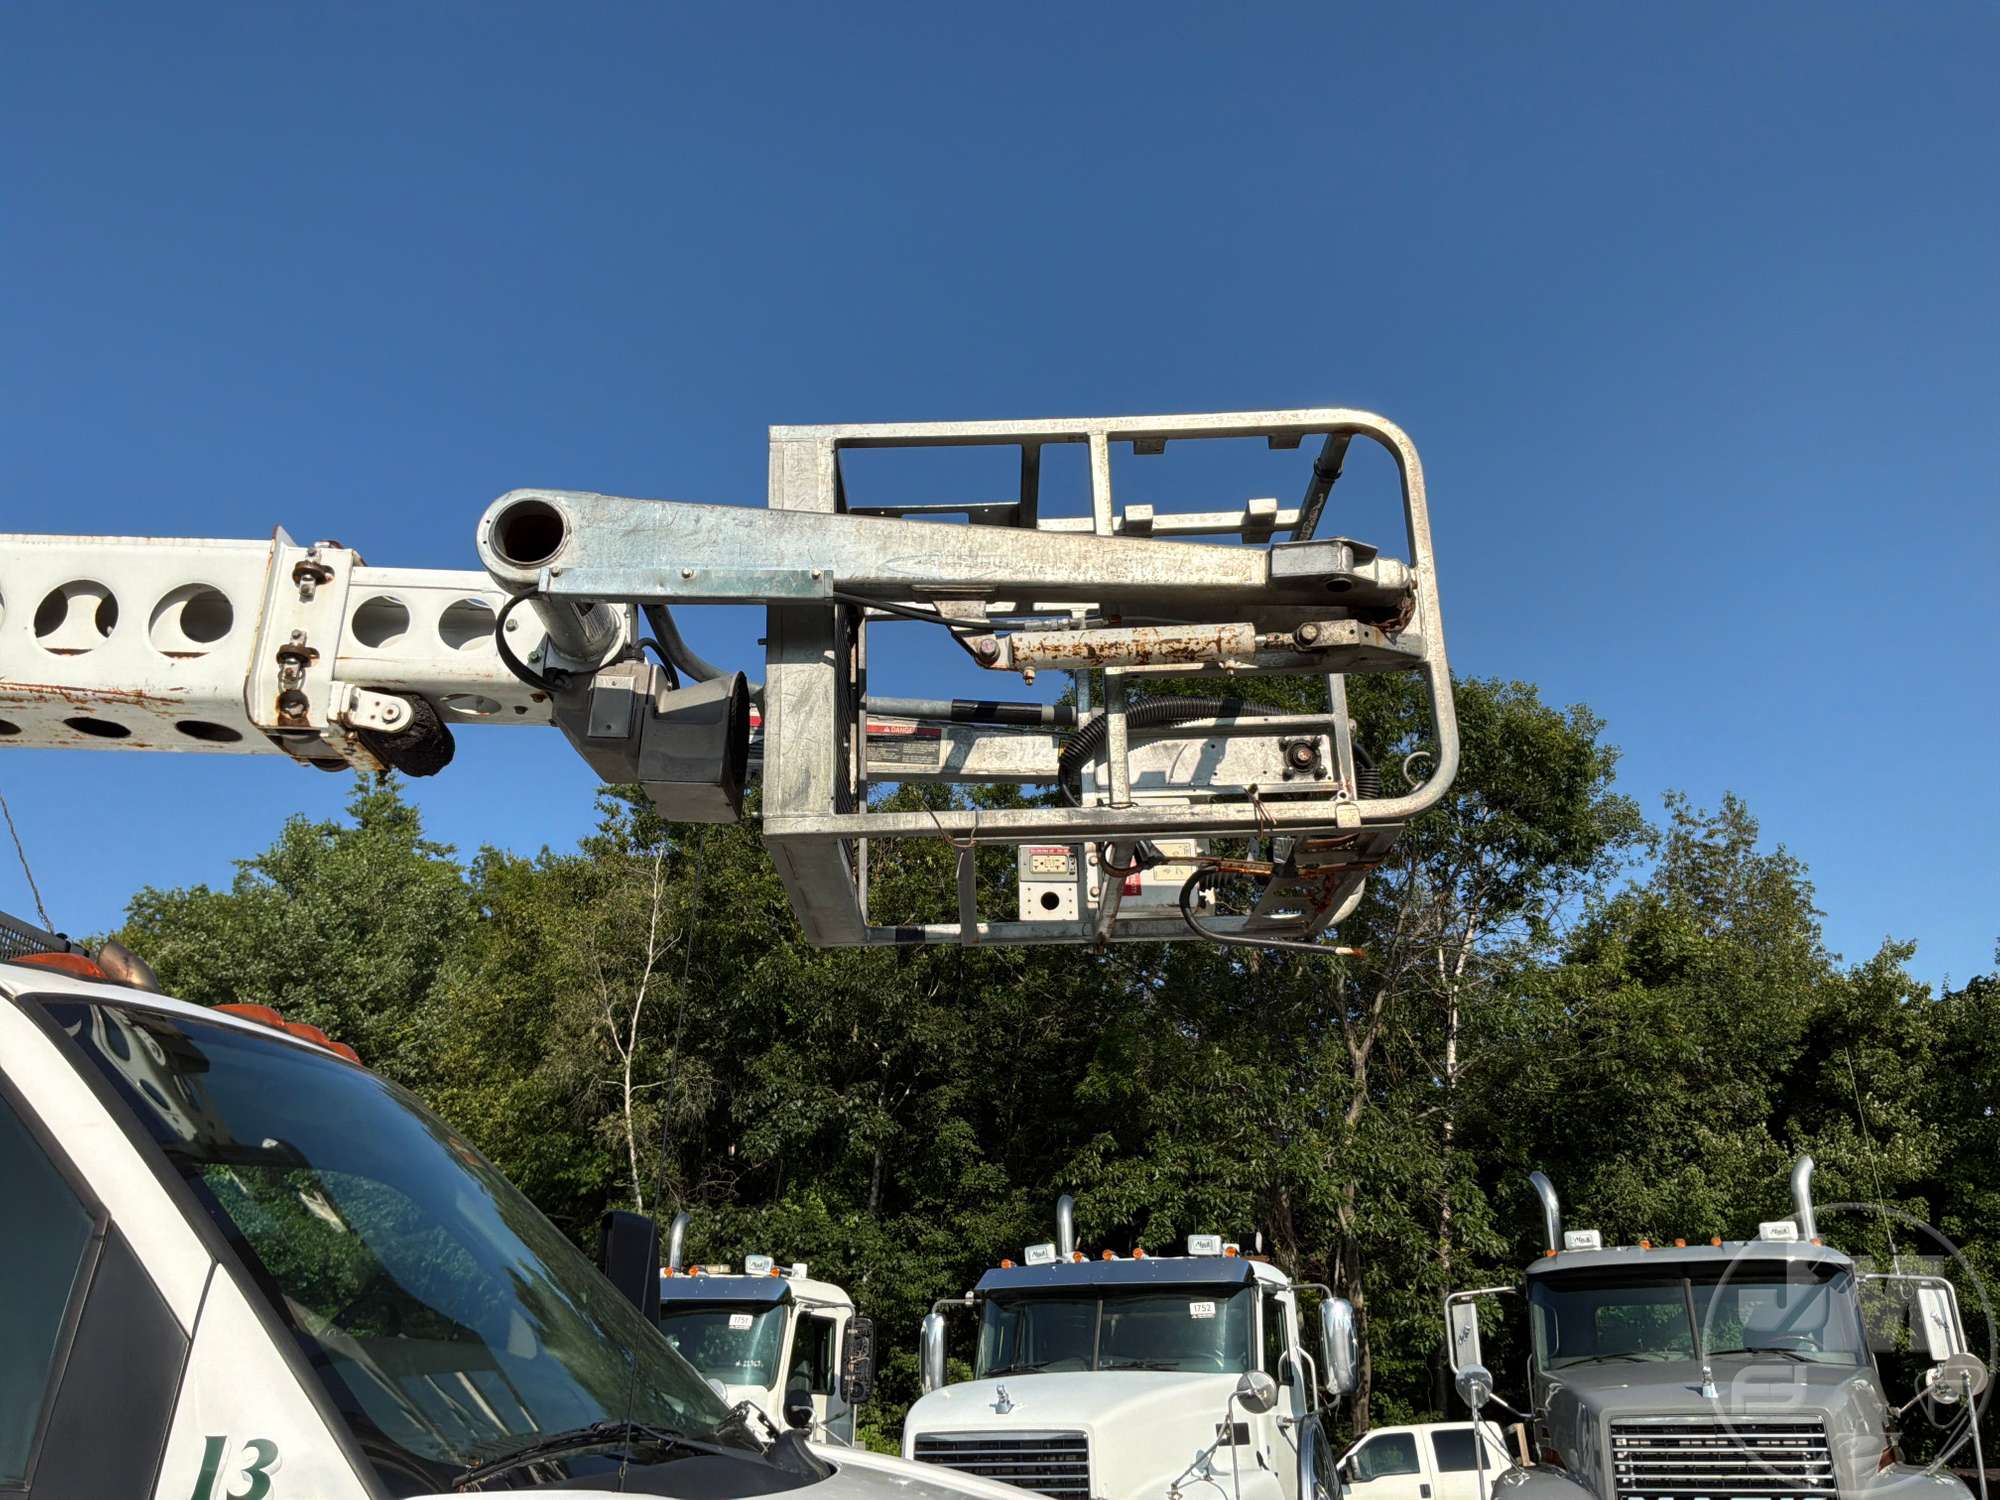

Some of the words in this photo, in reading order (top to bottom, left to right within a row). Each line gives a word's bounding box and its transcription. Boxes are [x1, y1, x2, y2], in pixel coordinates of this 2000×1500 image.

[1194, 1303, 1212, 1313] 1752
[734, 1316, 748, 1324] 1751
[190, 1435, 279, 1500] 13
